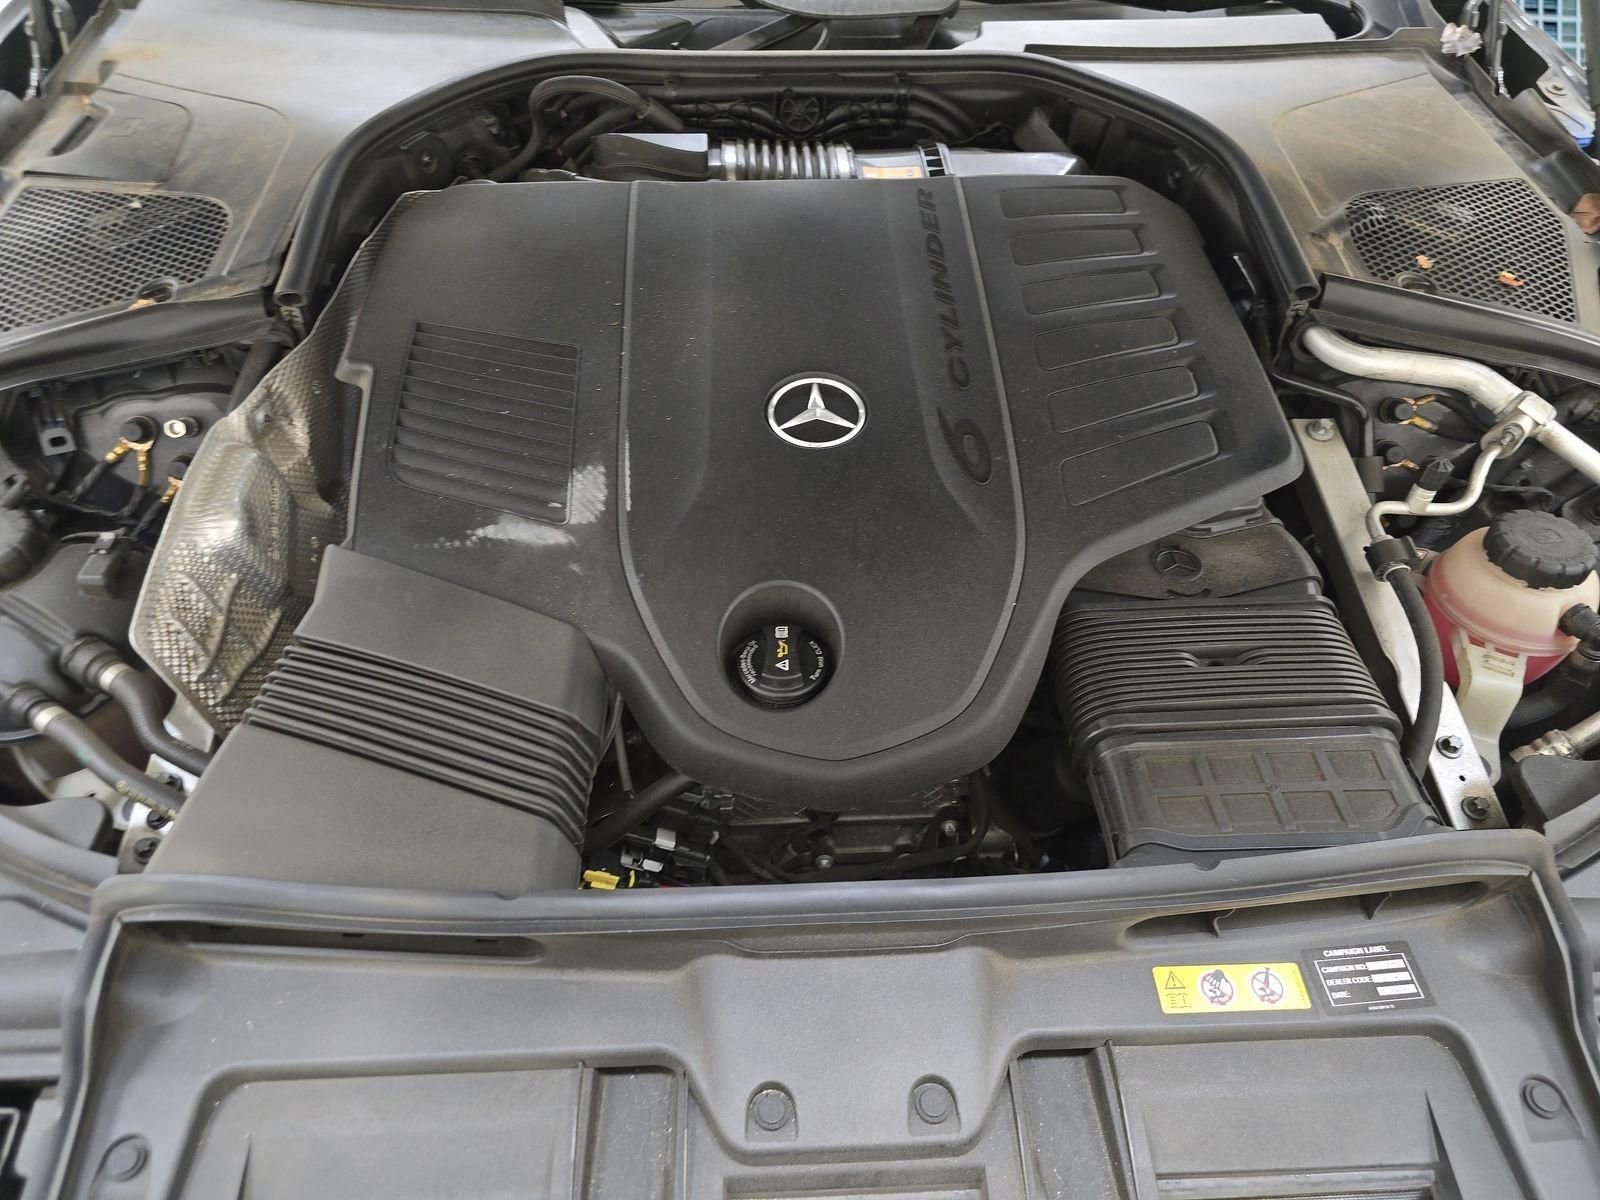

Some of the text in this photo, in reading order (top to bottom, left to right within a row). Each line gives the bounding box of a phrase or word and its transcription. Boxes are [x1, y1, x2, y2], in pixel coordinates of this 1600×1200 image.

[917, 188, 992, 485] 6 CYLINDER
[1323, 945, 1390, 957] CAMPAIGN LABEL
[1321, 964, 1355, 973] CAMPAIGN
[1326, 978, 1352, 986] DEALER
